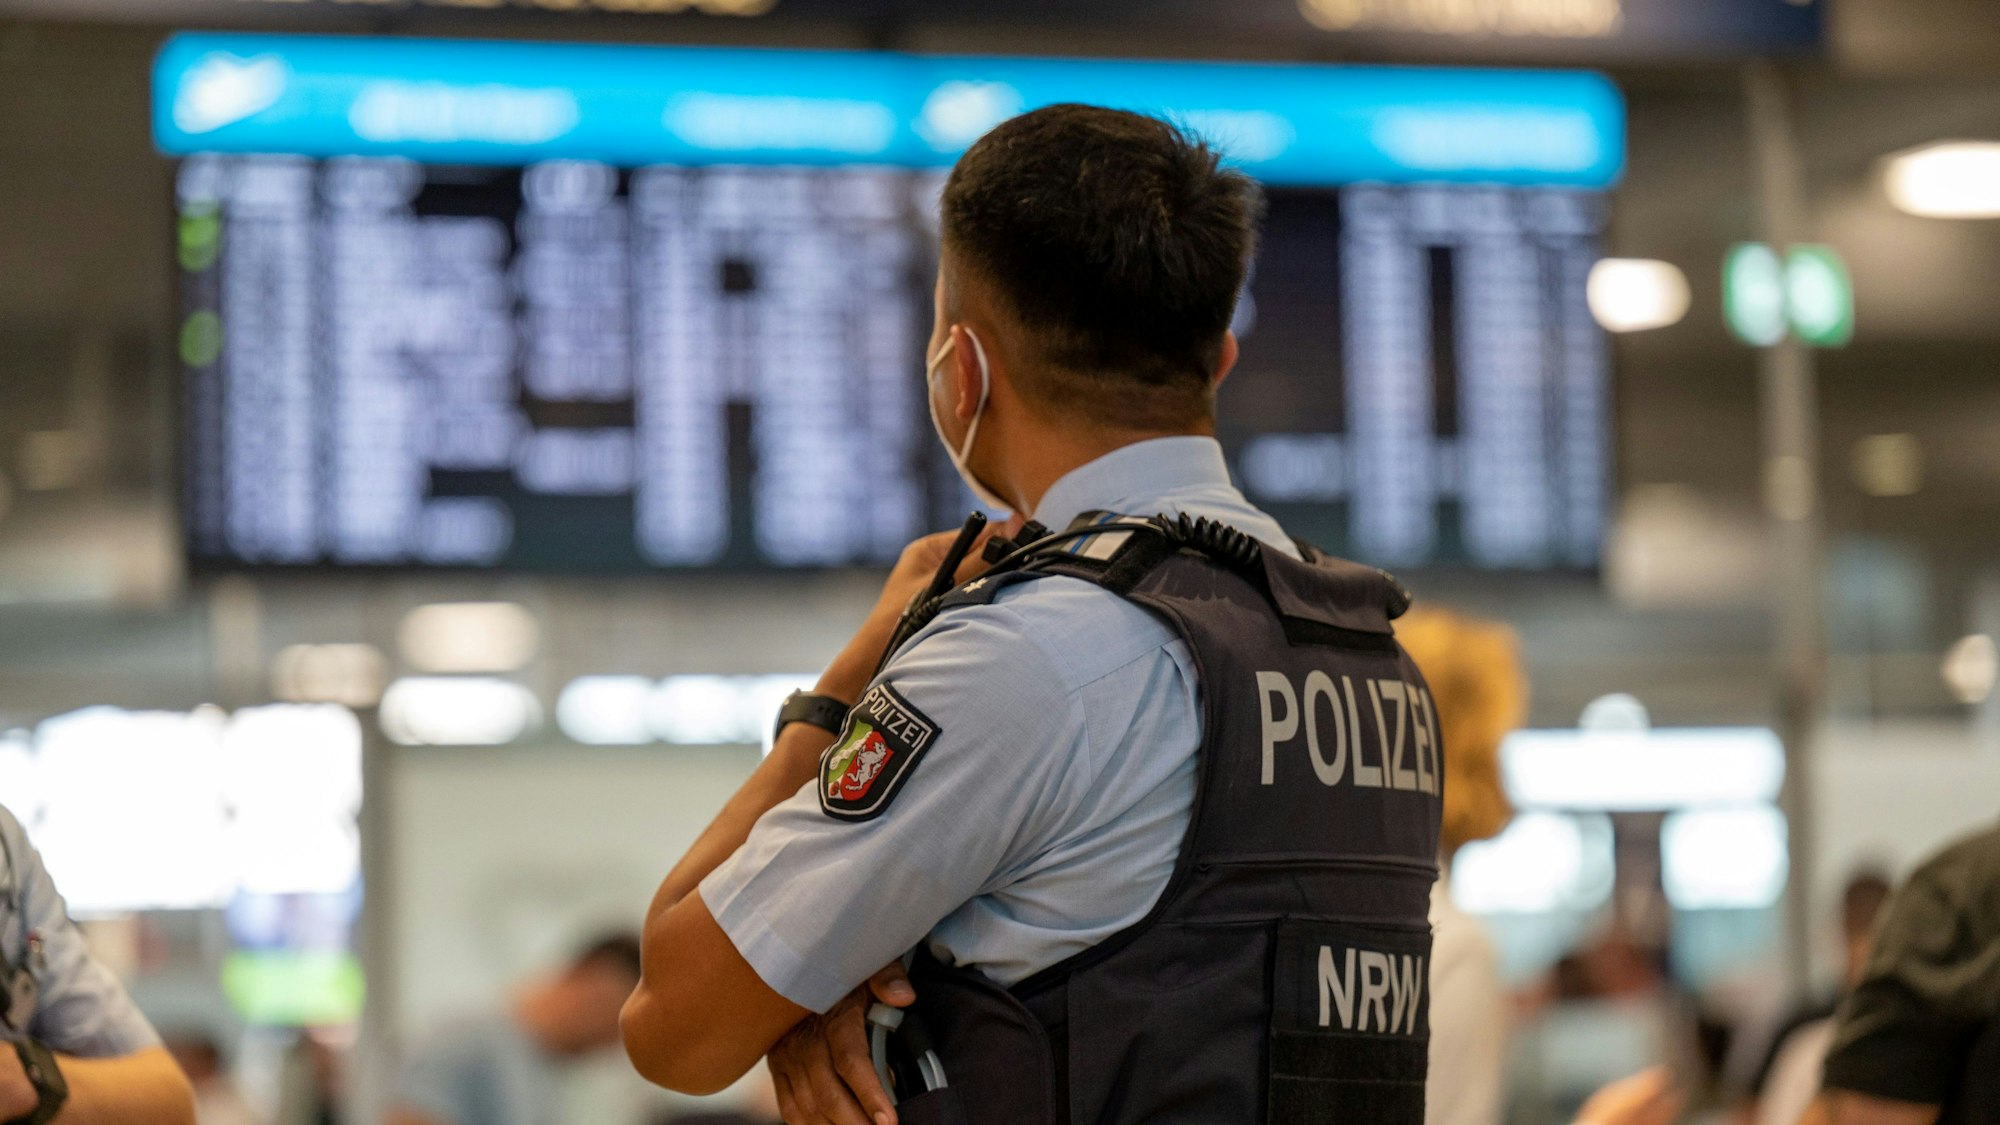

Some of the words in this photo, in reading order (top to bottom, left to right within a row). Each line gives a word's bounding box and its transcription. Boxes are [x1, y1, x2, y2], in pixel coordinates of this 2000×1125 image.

[864, 689, 925, 748] POLIZEI
[1256, 669, 1440, 797] POLIZEI
[1318, 945, 1422, 1035] NRW
